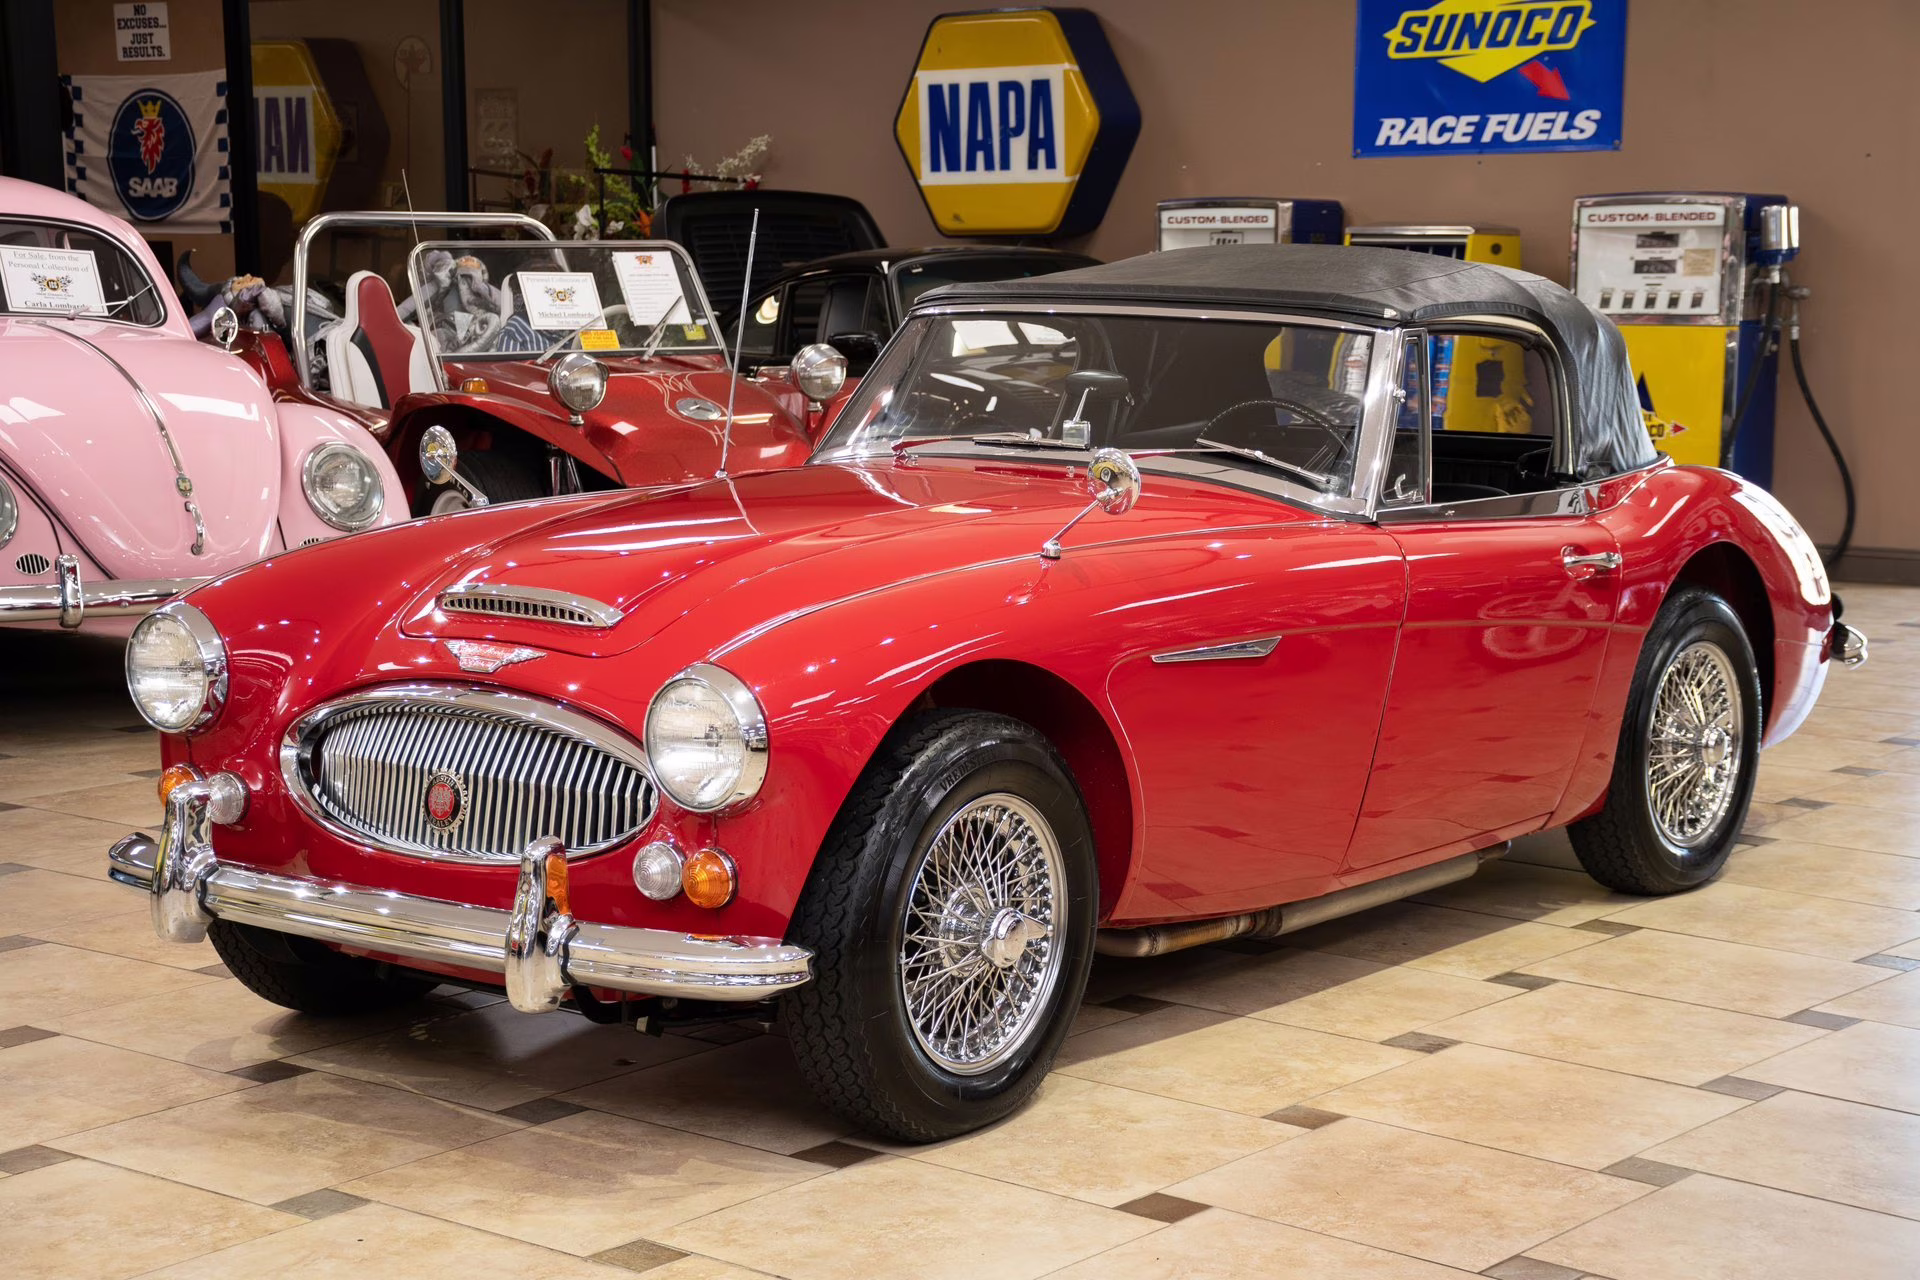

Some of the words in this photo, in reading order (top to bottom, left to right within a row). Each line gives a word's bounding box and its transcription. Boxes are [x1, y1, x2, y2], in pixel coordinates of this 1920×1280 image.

[133, 4, 146, 16] NO
[117, 17, 167, 30] EXCUSES...
[1394, 6, 1585, 53] SUNOCO
[130, 33, 154, 45] JUST
[122, 46, 166, 59] RESULTS.
[928, 79, 1057, 172] NAPA
[1375, 115, 1481, 146] RACE
[1480, 109, 1602, 143] FUELS
[128, 177, 178, 198] SAAB
[48, 253, 67, 261] from
[67, 253, 80, 262] the
[8, 261, 40, 270] Personal
[41, 263, 80, 272] Collection
[80, 265, 89, 273] of
[24, 300, 47, 308] Carla
[49, 301, 86, 310] Lombard
